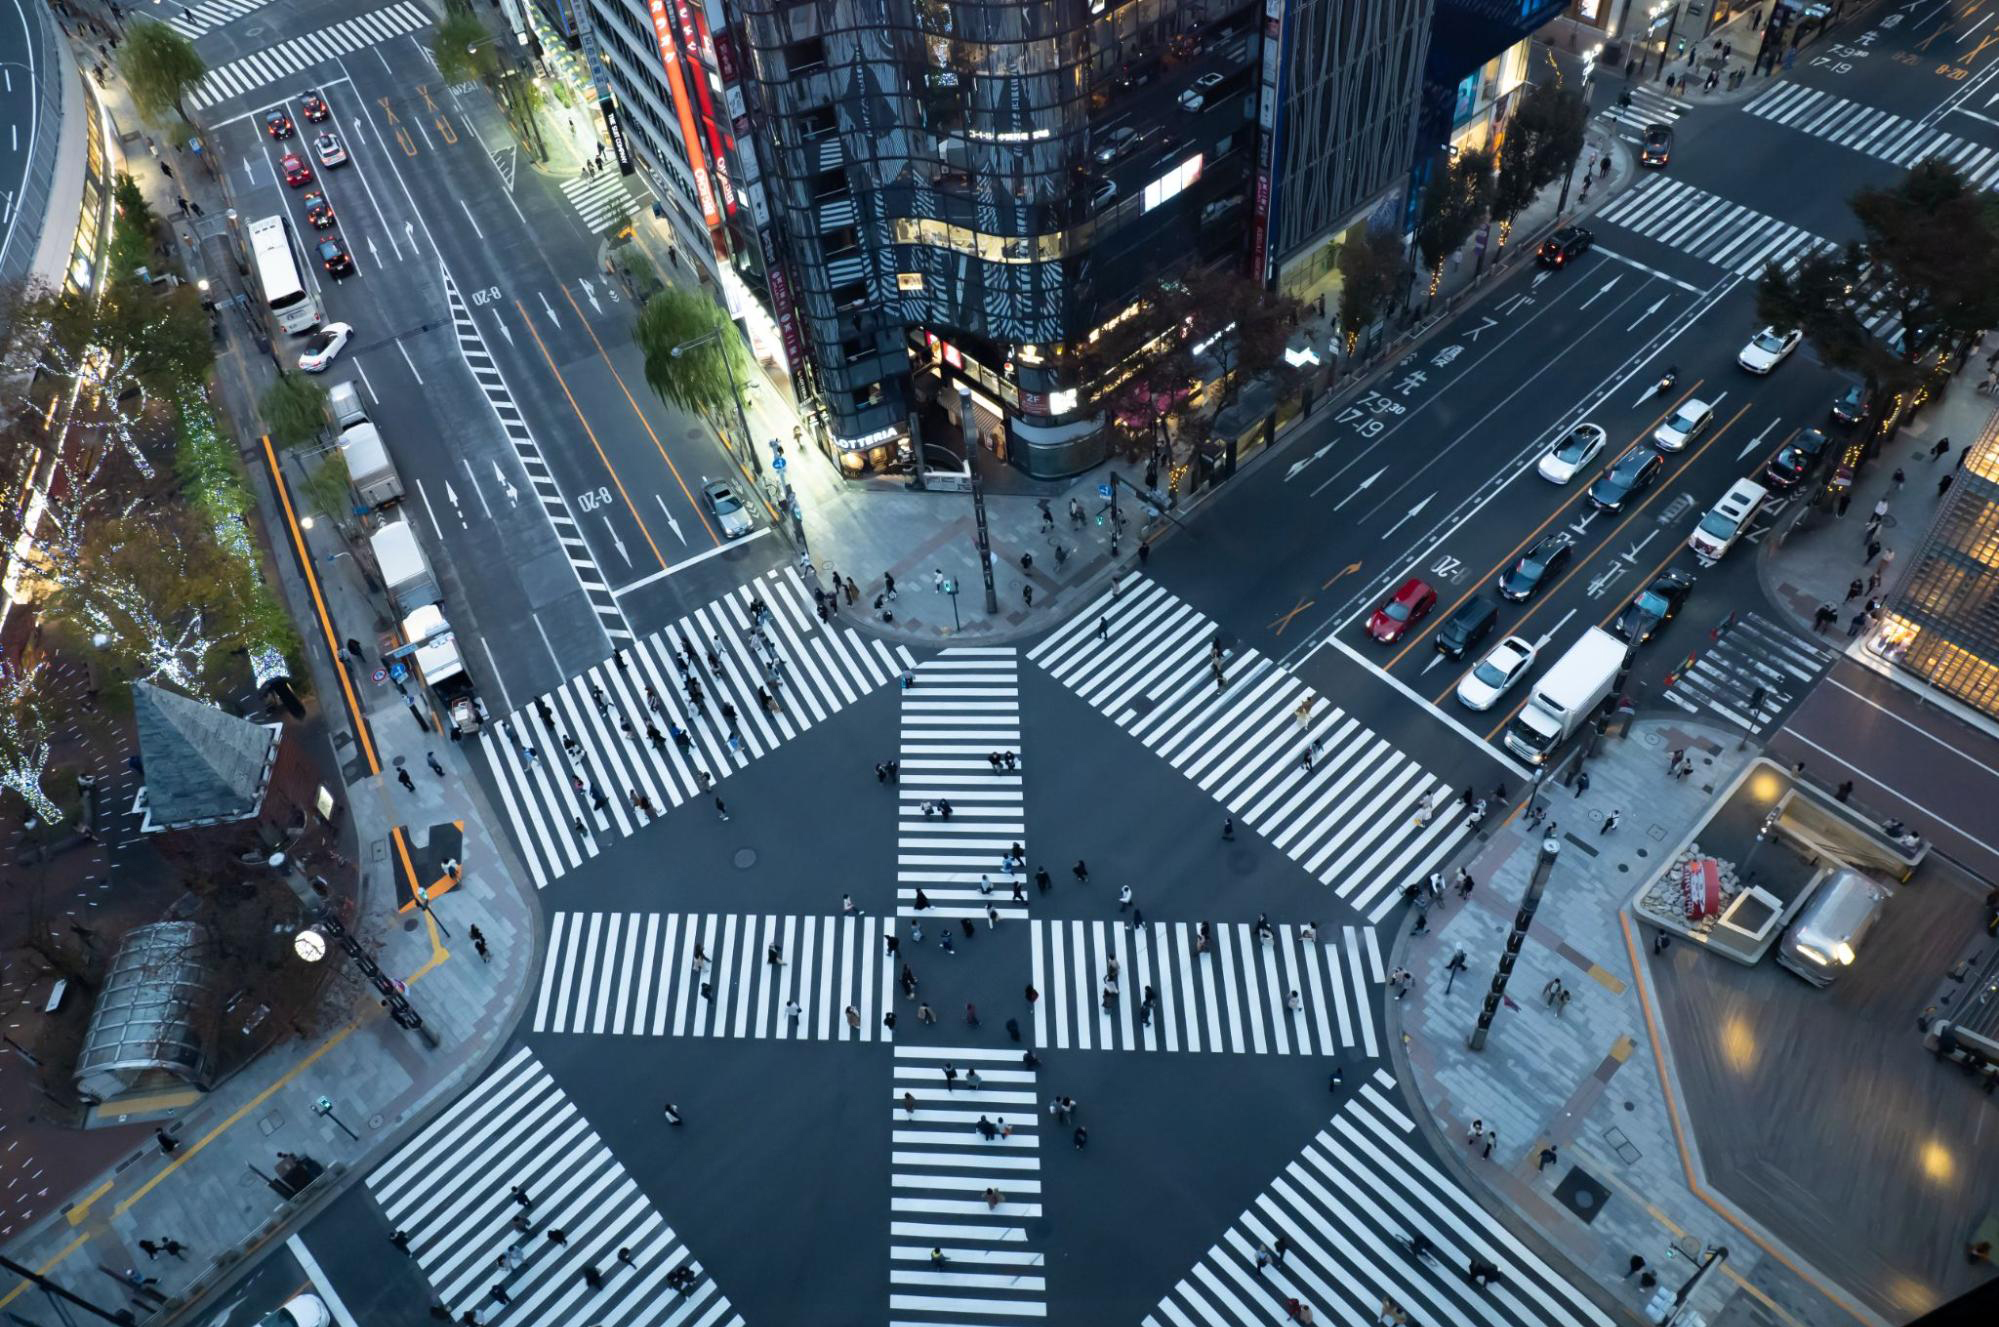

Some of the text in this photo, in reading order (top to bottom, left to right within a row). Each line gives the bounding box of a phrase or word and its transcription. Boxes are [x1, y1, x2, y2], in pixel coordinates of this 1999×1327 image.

[1809, 56, 1852, 75] 17-19
[1935, 64, 1968, 80] 8-20
[472, 286, 502, 306] 8-20
[1026, 393, 1040, 403] 2F
[1335, 407, 1385, 438] 17-19
[832, 427, 898, 449] LOTTERIA
[577, 486, 613, 513] 8-20
[1431, 555, 1473, 586] 8-20
